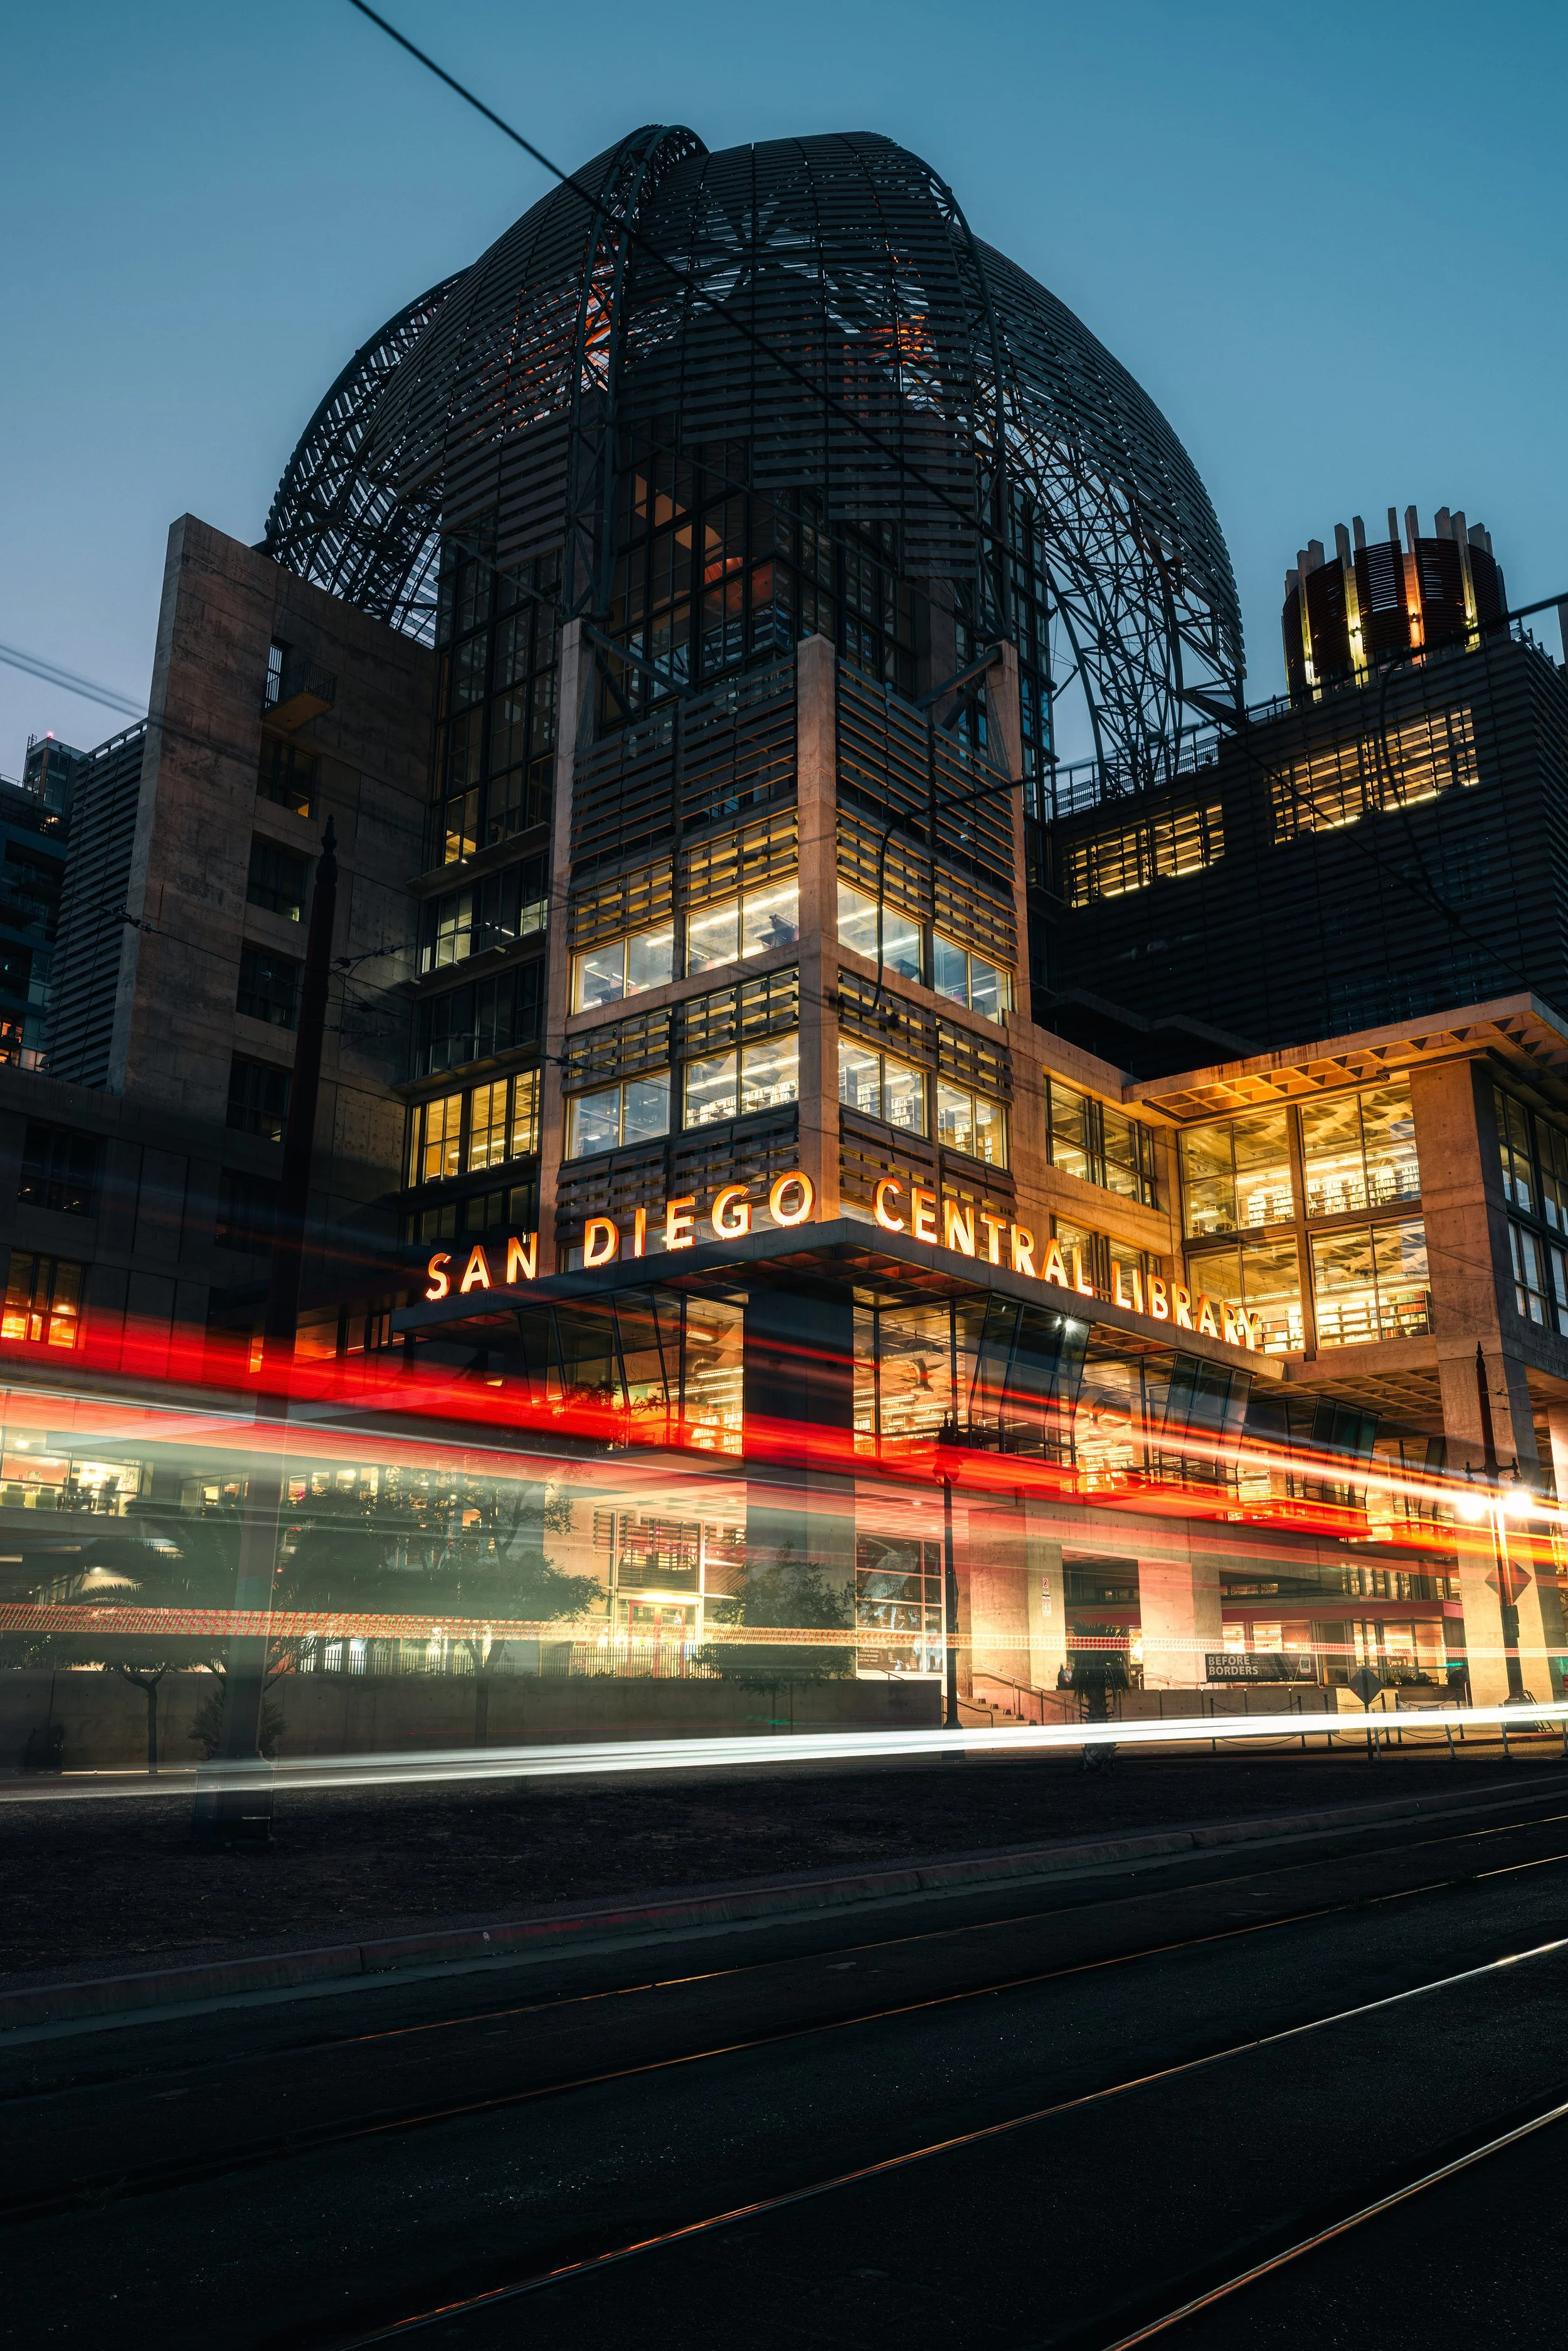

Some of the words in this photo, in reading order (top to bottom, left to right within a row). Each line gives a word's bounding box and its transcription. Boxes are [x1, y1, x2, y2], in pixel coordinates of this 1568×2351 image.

[425, 1232, 540, 1300] SAN
[583, 1170, 814, 1268] DIEGO
[872, 1177, 1093, 1297] CENTRAL
[1111, 1261, 1259, 1351] LIBRARY
[1208, 1656, 1250, 1665] BEFORE
[1209, 1666, 1259, 1675] BORDERS
